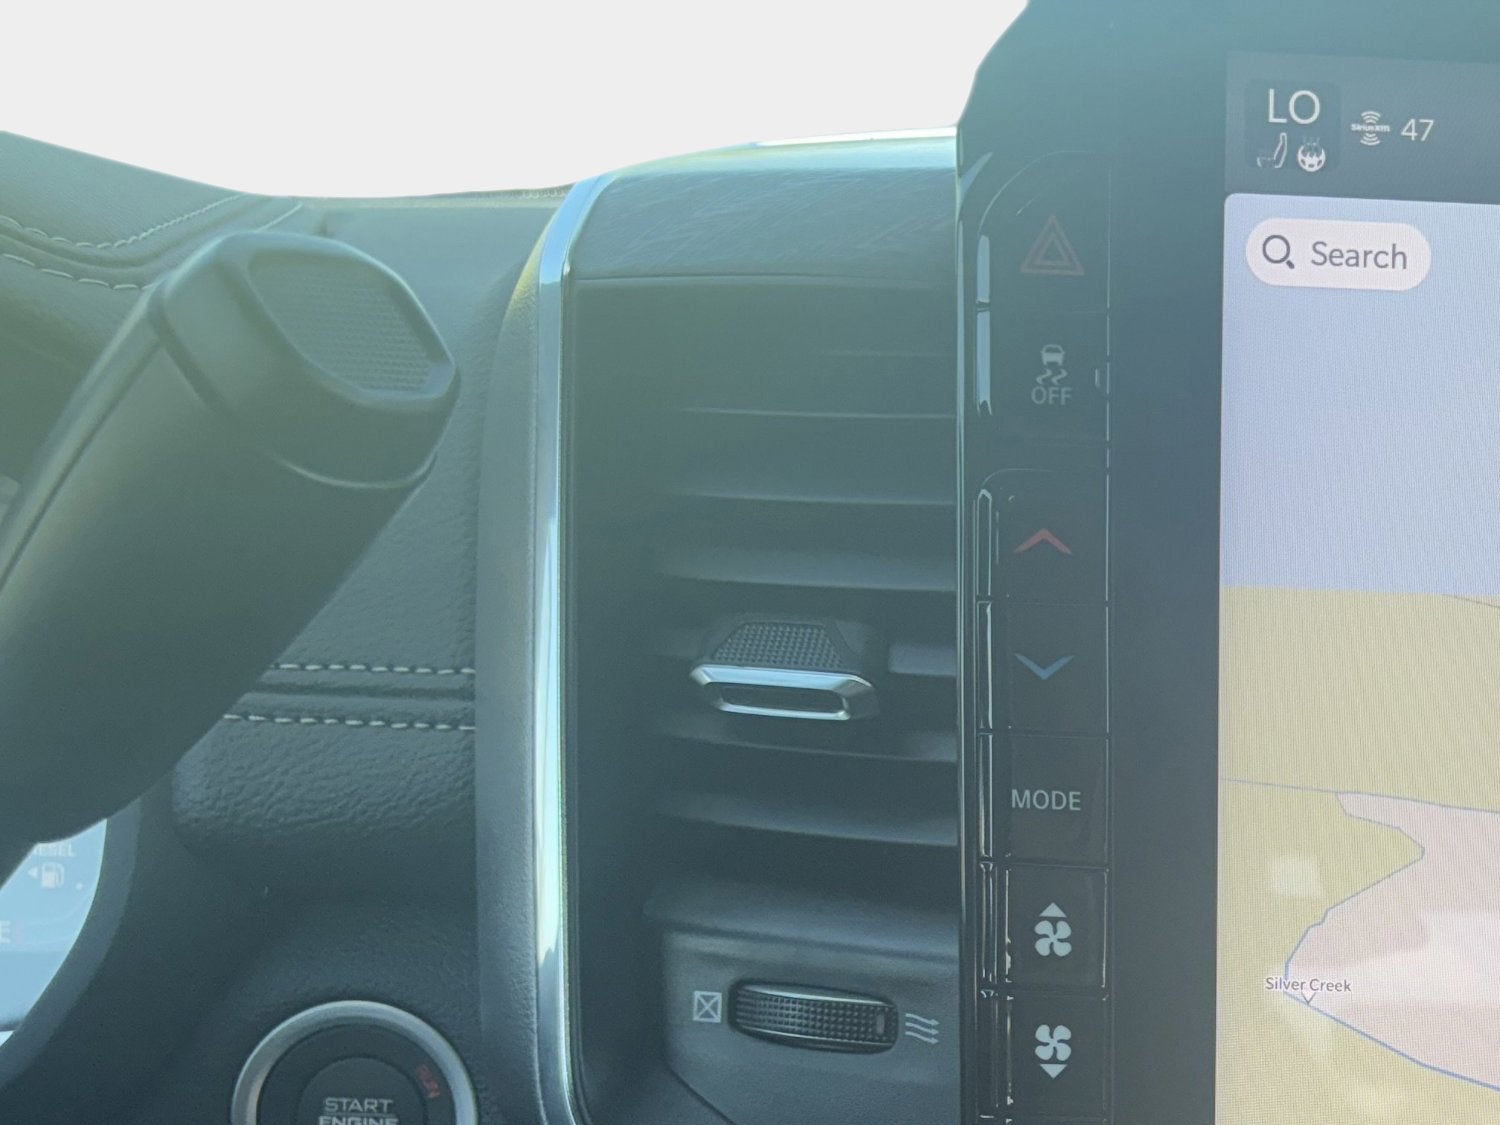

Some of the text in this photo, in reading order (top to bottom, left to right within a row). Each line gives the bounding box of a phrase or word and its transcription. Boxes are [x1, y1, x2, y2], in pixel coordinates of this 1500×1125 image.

[1266, 88, 1321, 125] LO
[1400, 117, 1435, 142] 47
[1309, 240, 1408, 271] Search
[1031, 386, 1073, 406] OFF
[1011, 788, 1082, 812] MODE
[1265, 976, 1352, 994] Silver Creek
[324, 1096, 394, 1113] START
